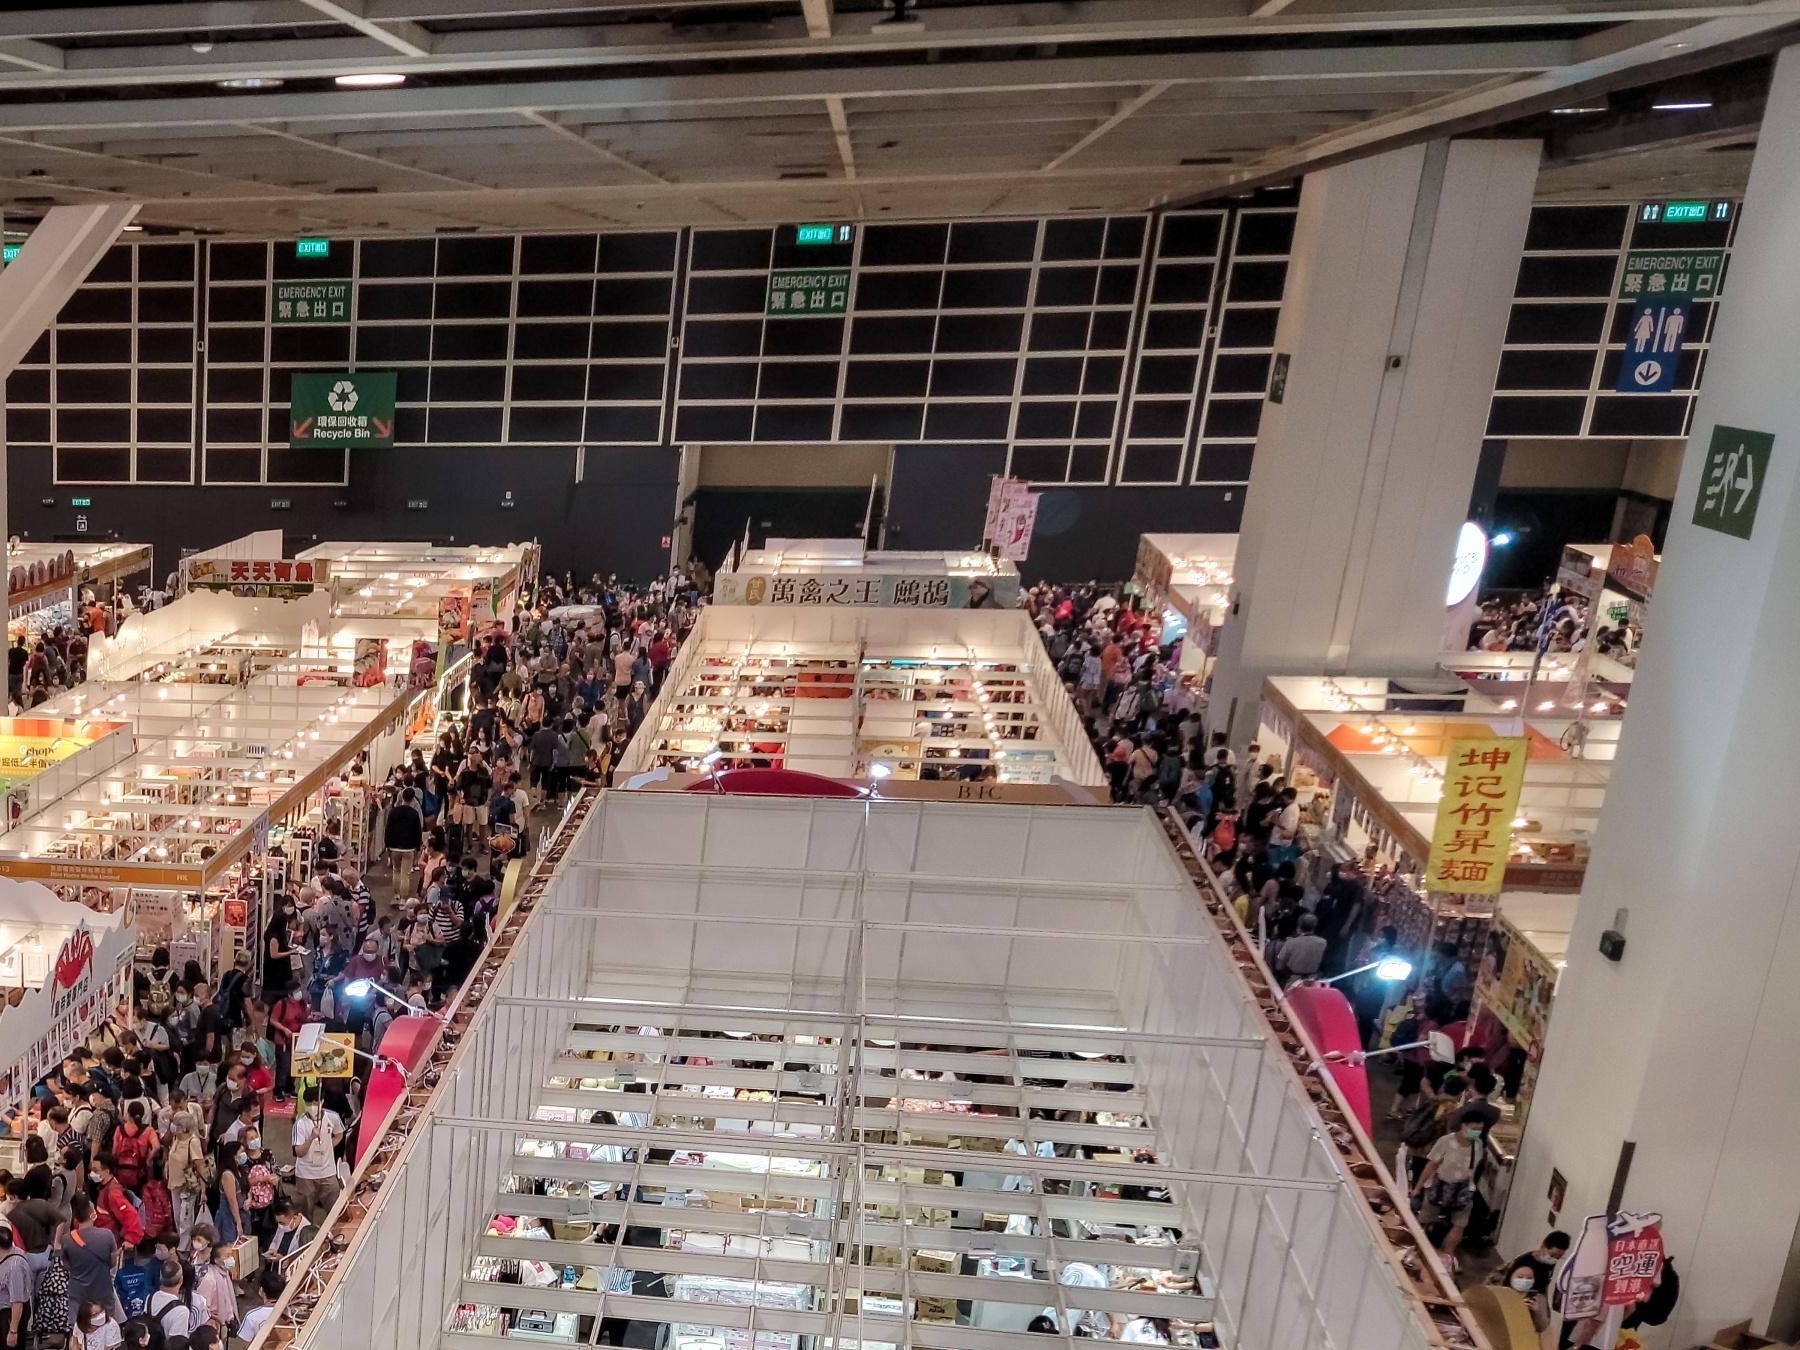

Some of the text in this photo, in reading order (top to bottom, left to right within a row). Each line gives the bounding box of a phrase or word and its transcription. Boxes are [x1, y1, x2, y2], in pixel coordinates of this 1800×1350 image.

[1627, 255, 1720, 271] EMERGENCY EXIT
[772, 273, 848, 290] EMERGENCY EXIT
[1624, 272, 1714, 293] 緊急出口
[278, 285, 346, 299] EMERGENCY EXIT
[770, 290, 846, 310] 緊急出口
[278, 300, 345, 319] 緊急出口
[316, 415, 369, 428] 環保回收箱
[313, 427, 371, 441] Recycle Bin
[770, 576, 950, 607] 萬禽之王 鷓鴣
[1609, 1251, 1660, 1281] 空運
